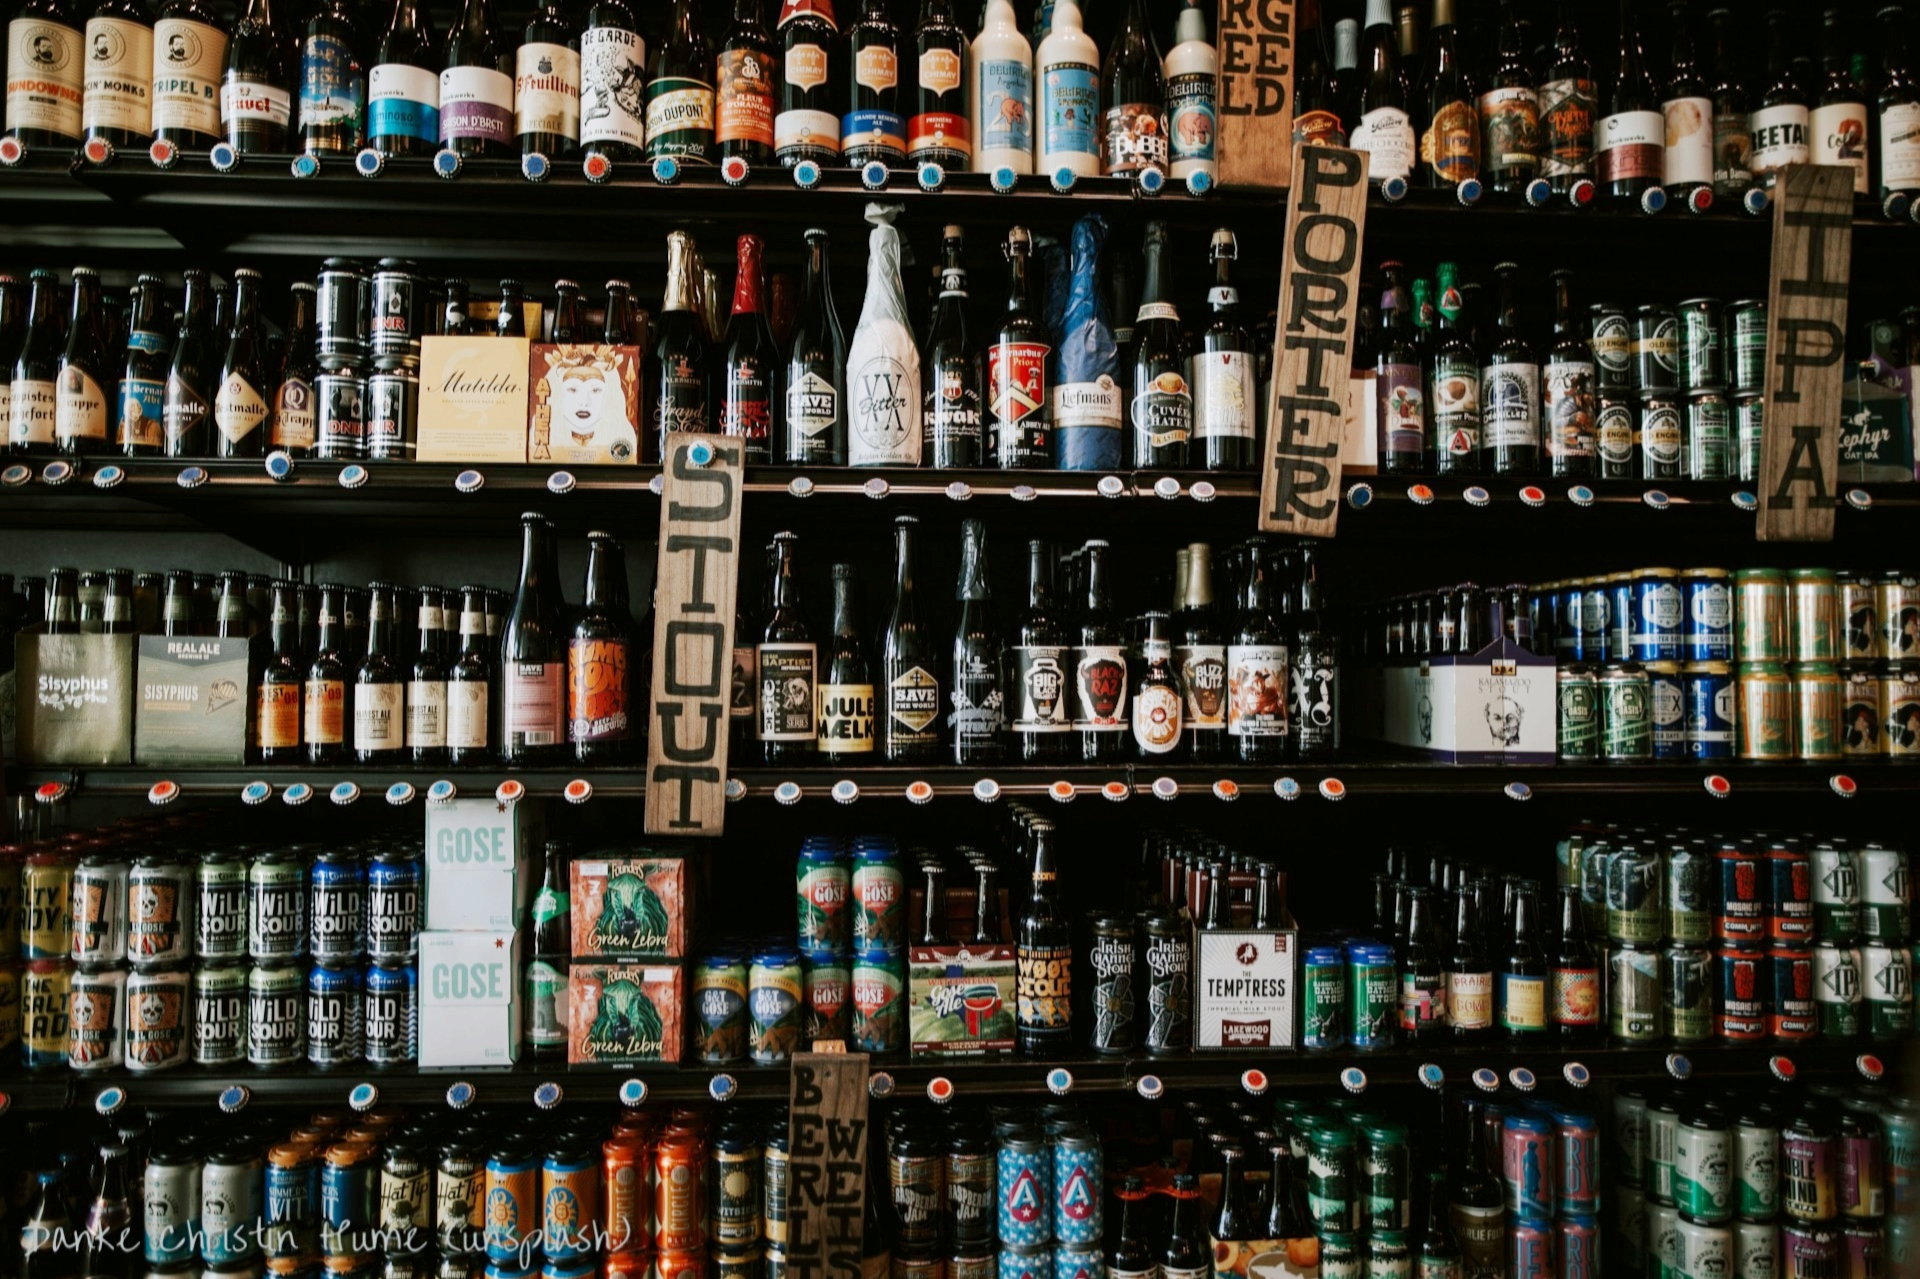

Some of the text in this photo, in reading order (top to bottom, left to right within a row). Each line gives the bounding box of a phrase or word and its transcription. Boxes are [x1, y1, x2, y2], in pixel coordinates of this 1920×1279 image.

[584, 29, 636, 47] DE GARDE
[789, 65, 825, 75] CHIMAY
[861, 68, 894, 80] CHIMAY
[924, 70, 956, 81] CHIMAY
[104, 80, 145, 98] MONKS
[153, 79, 213, 98] TRIPEL B
[664, 104, 703, 123] DUPONT
[1270, 152, 1362, 521] PORTER
[1013, 357, 1035, 368] Prior
[1768, 211, 1850, 509] IPA
[427, 370, 519, 394] Matilda
[285, 386, 305, 409] Q
[790, 395, 831, 407] SAVE
[857, 395, 909, 416] Bitter
[1061, 389, 1113, 410] Liefmans
[328, 419, 363, 436] DNR
[532, 377, 551, 460] ATHENA
[1843, 450, 1880, 460] OAT IPA
[653, 446, 740, 828] STOUT
[167, 642, 221, 656] REAL ALE
[1032, 672, 1056, 686] BIG
[1195, 664, 1223, 678] BUZZ
[38, 675, 109, 693] Sisyphus
[1195, 675, 1224, 690] NUTZ
[1478, 677, 1532, 687] KALAMAZOO
[144, 685, 199, 701] SISYPHUS
[282, 690, 298, 704] 08
[327, 686, 342, 700] 09
[895, 689, 936, 702] SAVE
[380, 709, 391, 719] ALE
[426, 704, 438, 714] ALE
[895, 701, 936, 711] THE WORLD
[436, 826, 507, 864] GOSE
[611, 863, 644, 879] Founders
[1832, 869, 1858, 898] IPA
[258, 891, 304, 917] WiLD
[313, 890, 360, 916] WiLD
[370, 890, 416, 917] WiLD
[814, 887, 845, 903] GOSE
[861, 887, 894, 903] GOSE
[1726, 901, 1752, 912] MOSAIC
[1782, 901, 1808, 912] MOSAIC
[200, 916, 248, 934] SOUR
[258, 916, 303, 935] SOUR
[313, 915, 359, 934] SOUR
[370, 915, 415, 934] SOUR
[588, 926, 669, 950] Green Zebra
[23, 978, 52, 993] THE
[431, 962, 504, 1000] GOSE
[607, 968, 640, 985] Founders
[927, 976, 997, 986] WATERMELON
[1453, 976, 1493, 989] PRAIRIE
[1833, 966, 1860, 996] IPA
[1883, 966, 1910, 996] IPA
[930, 984, 965, 1002] Gose
[1018, 977, 1071, 997] STOUT
[1207, 978, 1286, 998] TEMPTRESS
[1508, 980, 1541, 992] PRAIRIE
[704, 990, 727, 1004] G&T
[757, 989, 780, 1003] G&T
[812, 987, 844, 1004] GOSE
[854, 987, 884, 1004] GOSE
[194, 997, 242, 1020] WiLD
[250, 997, 297, 1021] WiLD
[701, 1001, 730, 1016] GOSE
[755, 1001, 782, 1016] GOSE
[936, 998, 963, 1018] Ale
[1724, 1000, 1749, 1011] MOSAIC
[1783, 999, 1808, 1011] MOSAIC
[147, 1030, 172, 1040] GOSE
[194, 1020, 241, 1040] SOUR
[250, 1021, 297, 1041] SOUR
[1222, 1024, 1269, 1035] LAKEWOOD
[581, 1031, 664, 1057] Green Zebra
[381, 1177, 431, 1210] Hat Tip
[436, 1178, 485, 1210] Hat Tip
[1010, 1177, 1041, 1209] A
[1064, 1174, 1094, 1206] A
[269, 1196, 303, 1222] WIT
[670, 1180, 691, 1234] CIRCLE
[903, 1204, 928, 1223] JAM
[956, 1202, 980, 1220] JAM
